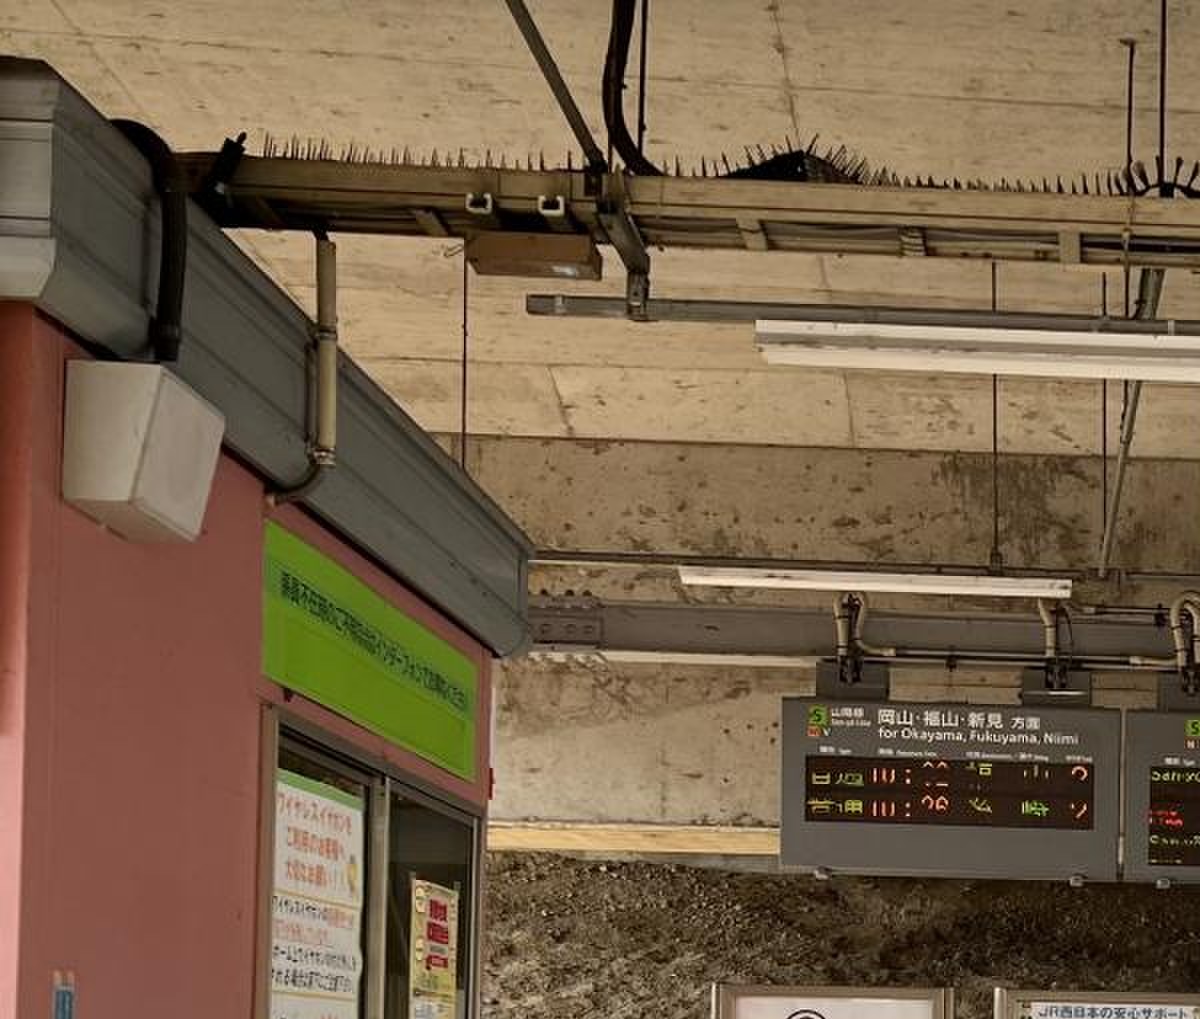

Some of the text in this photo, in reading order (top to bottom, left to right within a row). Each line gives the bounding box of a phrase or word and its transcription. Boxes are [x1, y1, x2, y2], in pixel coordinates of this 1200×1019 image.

[879, 726, 1079, 745] for Okayama, Fukuyama, Niimi
[1038, 1006, 1189, 1019] JR西日本の安心サポート
